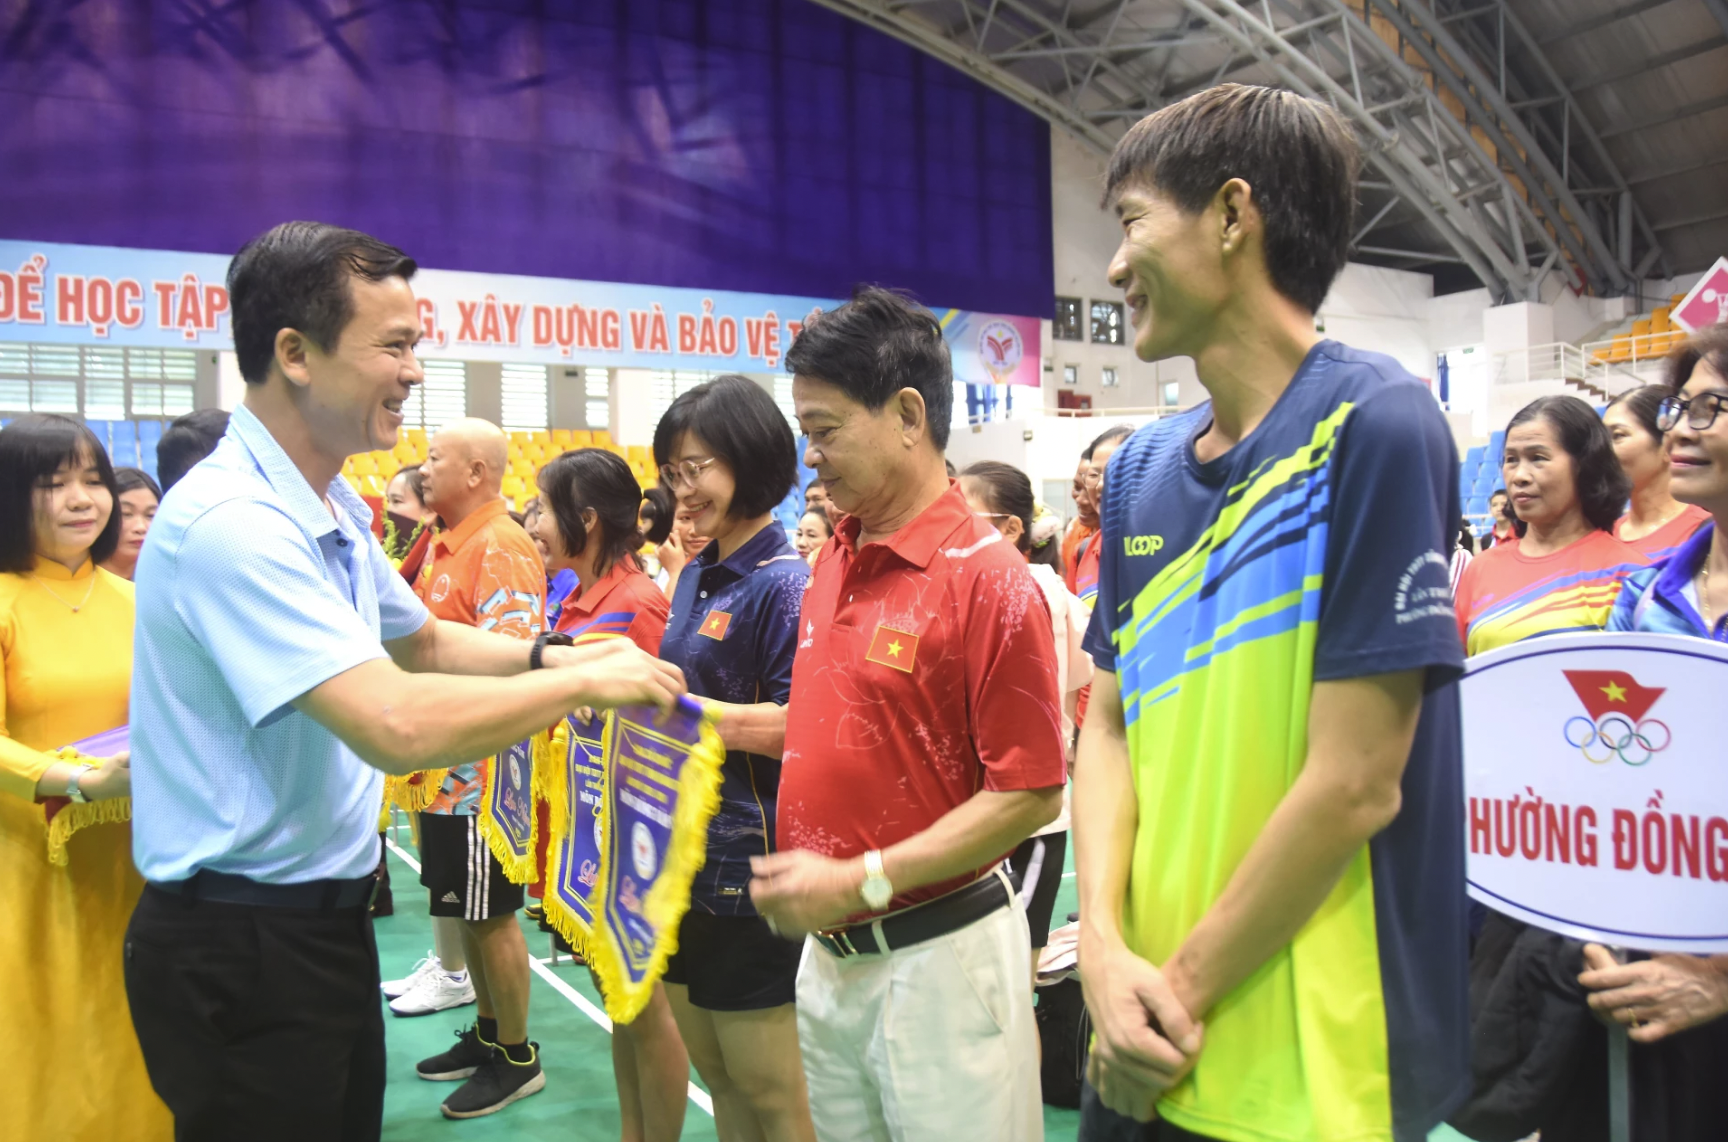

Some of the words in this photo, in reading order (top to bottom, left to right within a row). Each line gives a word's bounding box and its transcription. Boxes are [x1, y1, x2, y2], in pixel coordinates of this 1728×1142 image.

[0, 255, 46, 321] ĐỂ
[57, 276, 142, 335] HỌC
[154, 274, 230, 338] TẬP
[457, 294, 521, 343] XÂY
[533, 303, 619, 355] DỰNG
[630, 304, 669, 352] VÀ
[679, 299, 736, 355] BẢO
[746, 312, 778, 365] VỆ
[1464, 786, 1598, 867] HƯỜNG
[1611, 788, 1728, 883] ĐỒNG
